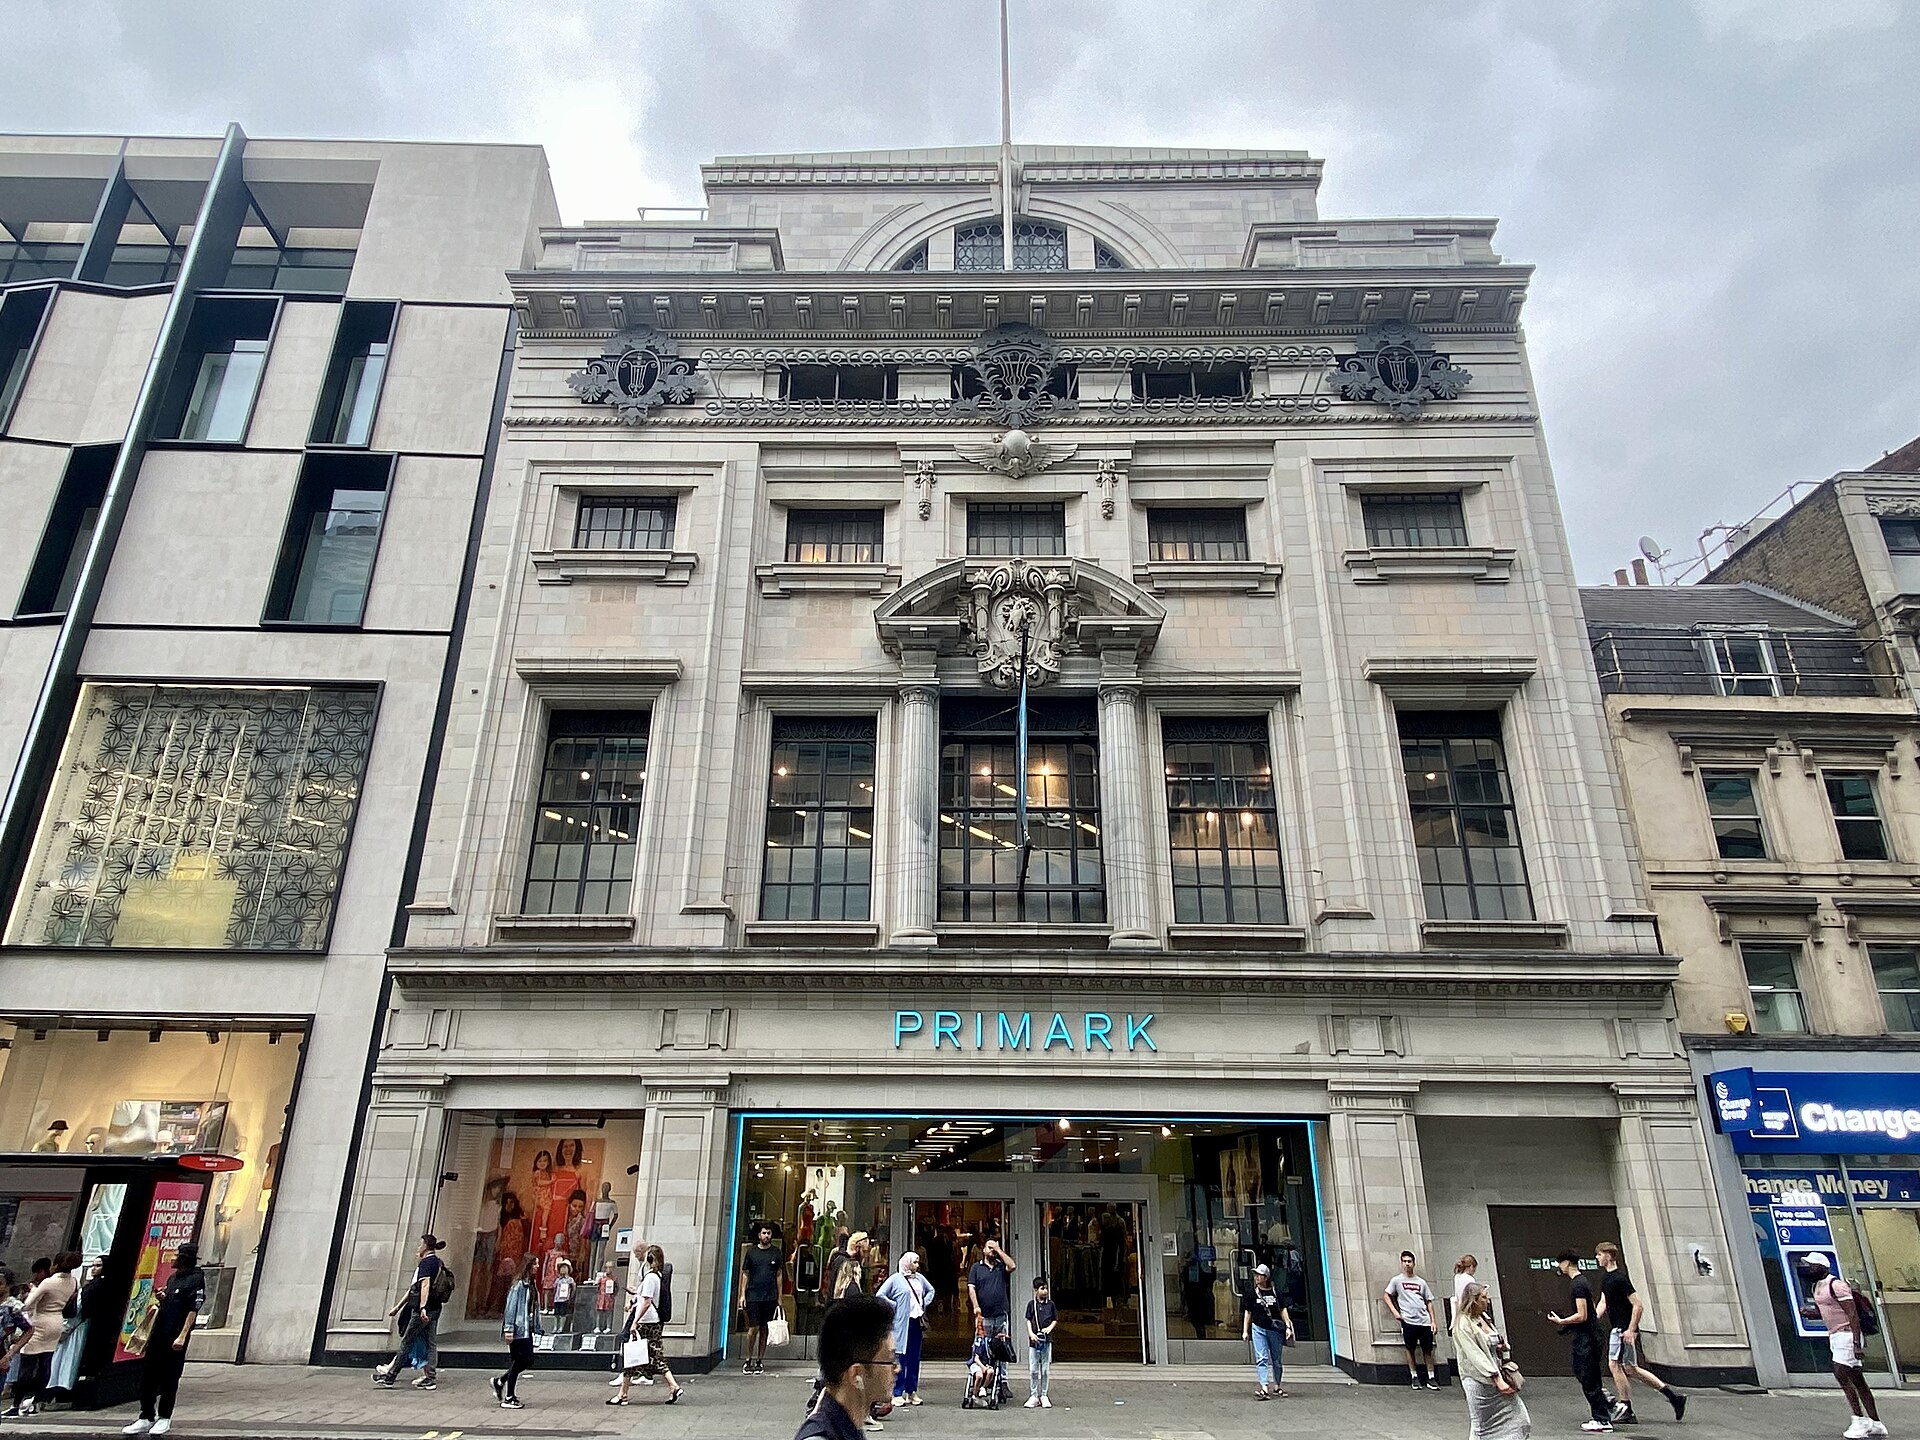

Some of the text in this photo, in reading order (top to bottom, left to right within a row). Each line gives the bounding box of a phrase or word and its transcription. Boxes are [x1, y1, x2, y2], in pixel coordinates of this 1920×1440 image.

[894, 1009, 1157, 1051] PRIMARK
[1719, 1098, 1750, 1110] Change
[1721, 1109, 1748, 1121] Group
[1801, 1102, 1920, 1139] Change
[1780, 1188, 1821, 1206] atm
[154, 1199, 198, 1211] MAKES YOUR
[151, 1212, 195, 1224] LUNCH HOUR
[1774, 1210, 1815, 1219] Free cash
[165, 1226, 193, 1237] FULL OF
